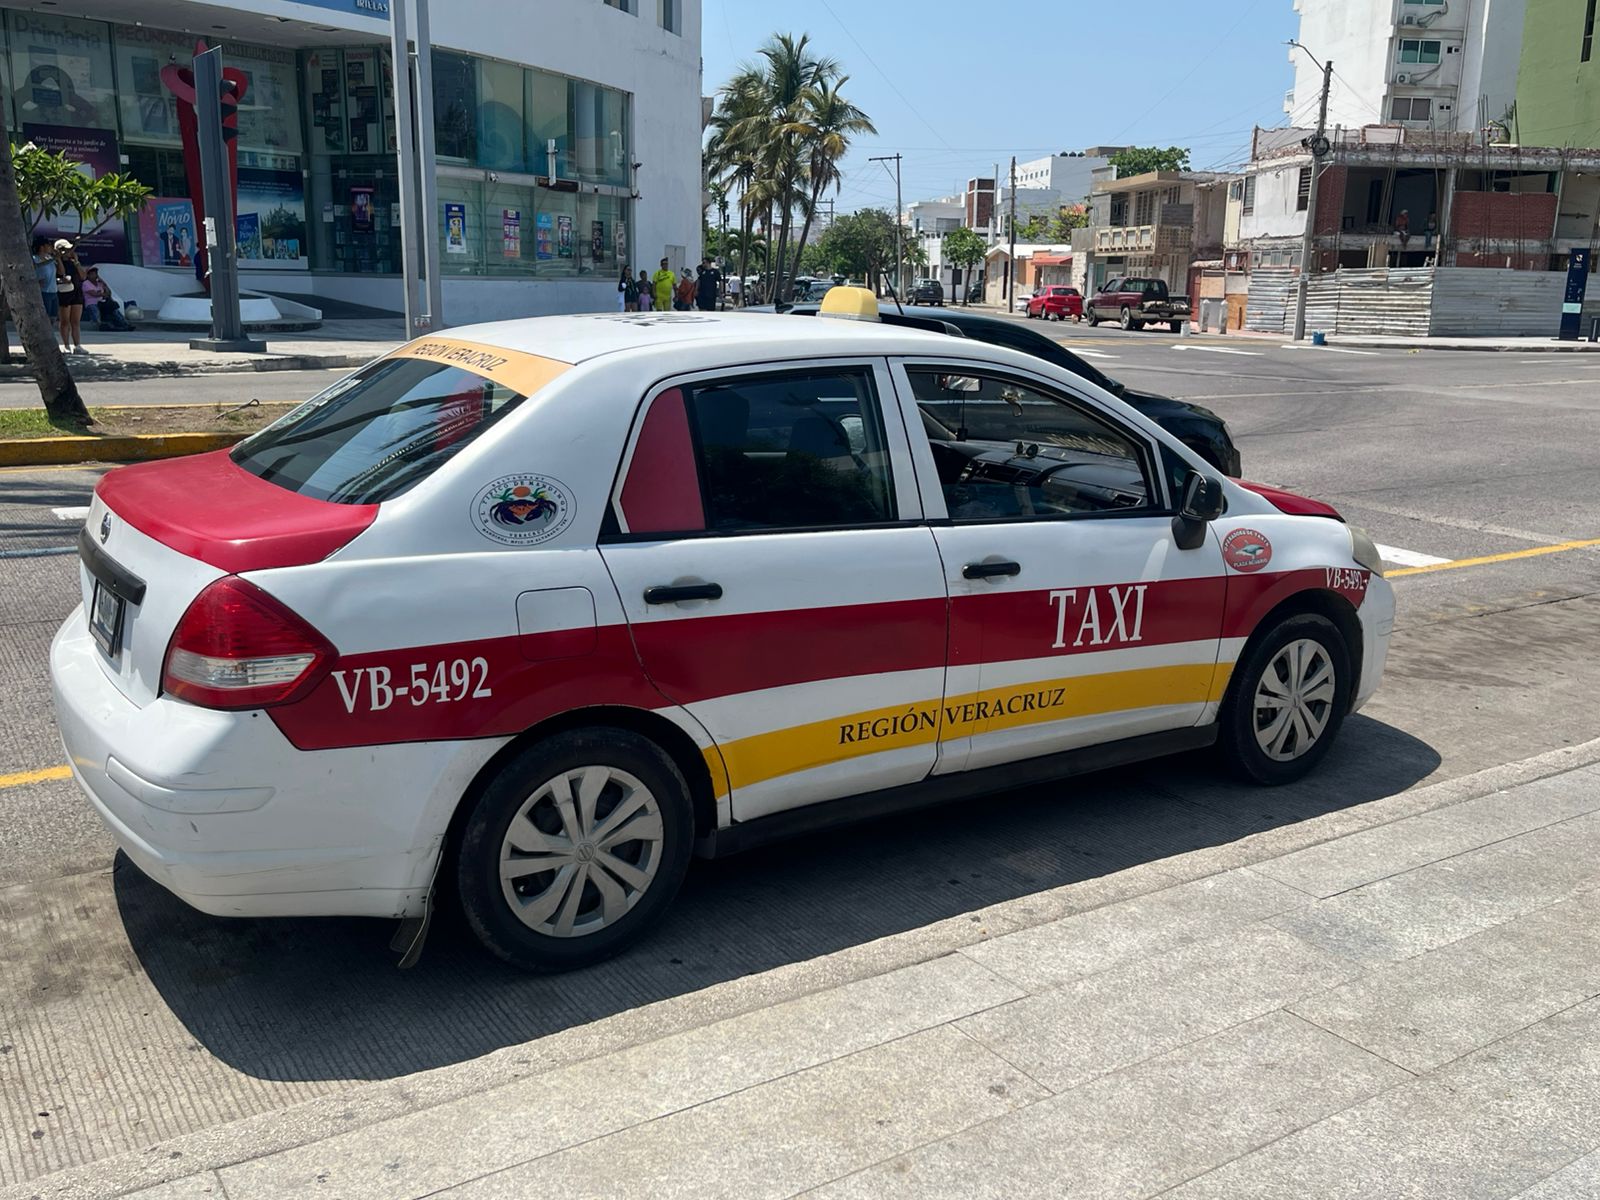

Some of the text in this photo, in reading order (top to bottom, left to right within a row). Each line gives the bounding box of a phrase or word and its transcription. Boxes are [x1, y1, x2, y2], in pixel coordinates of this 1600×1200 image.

[1049, 585, 1148, 648] TAXI
[331, 656, 492, 713] VB-5492
[838, 688, 1066, 744] REGIÓN VERACRUZ
